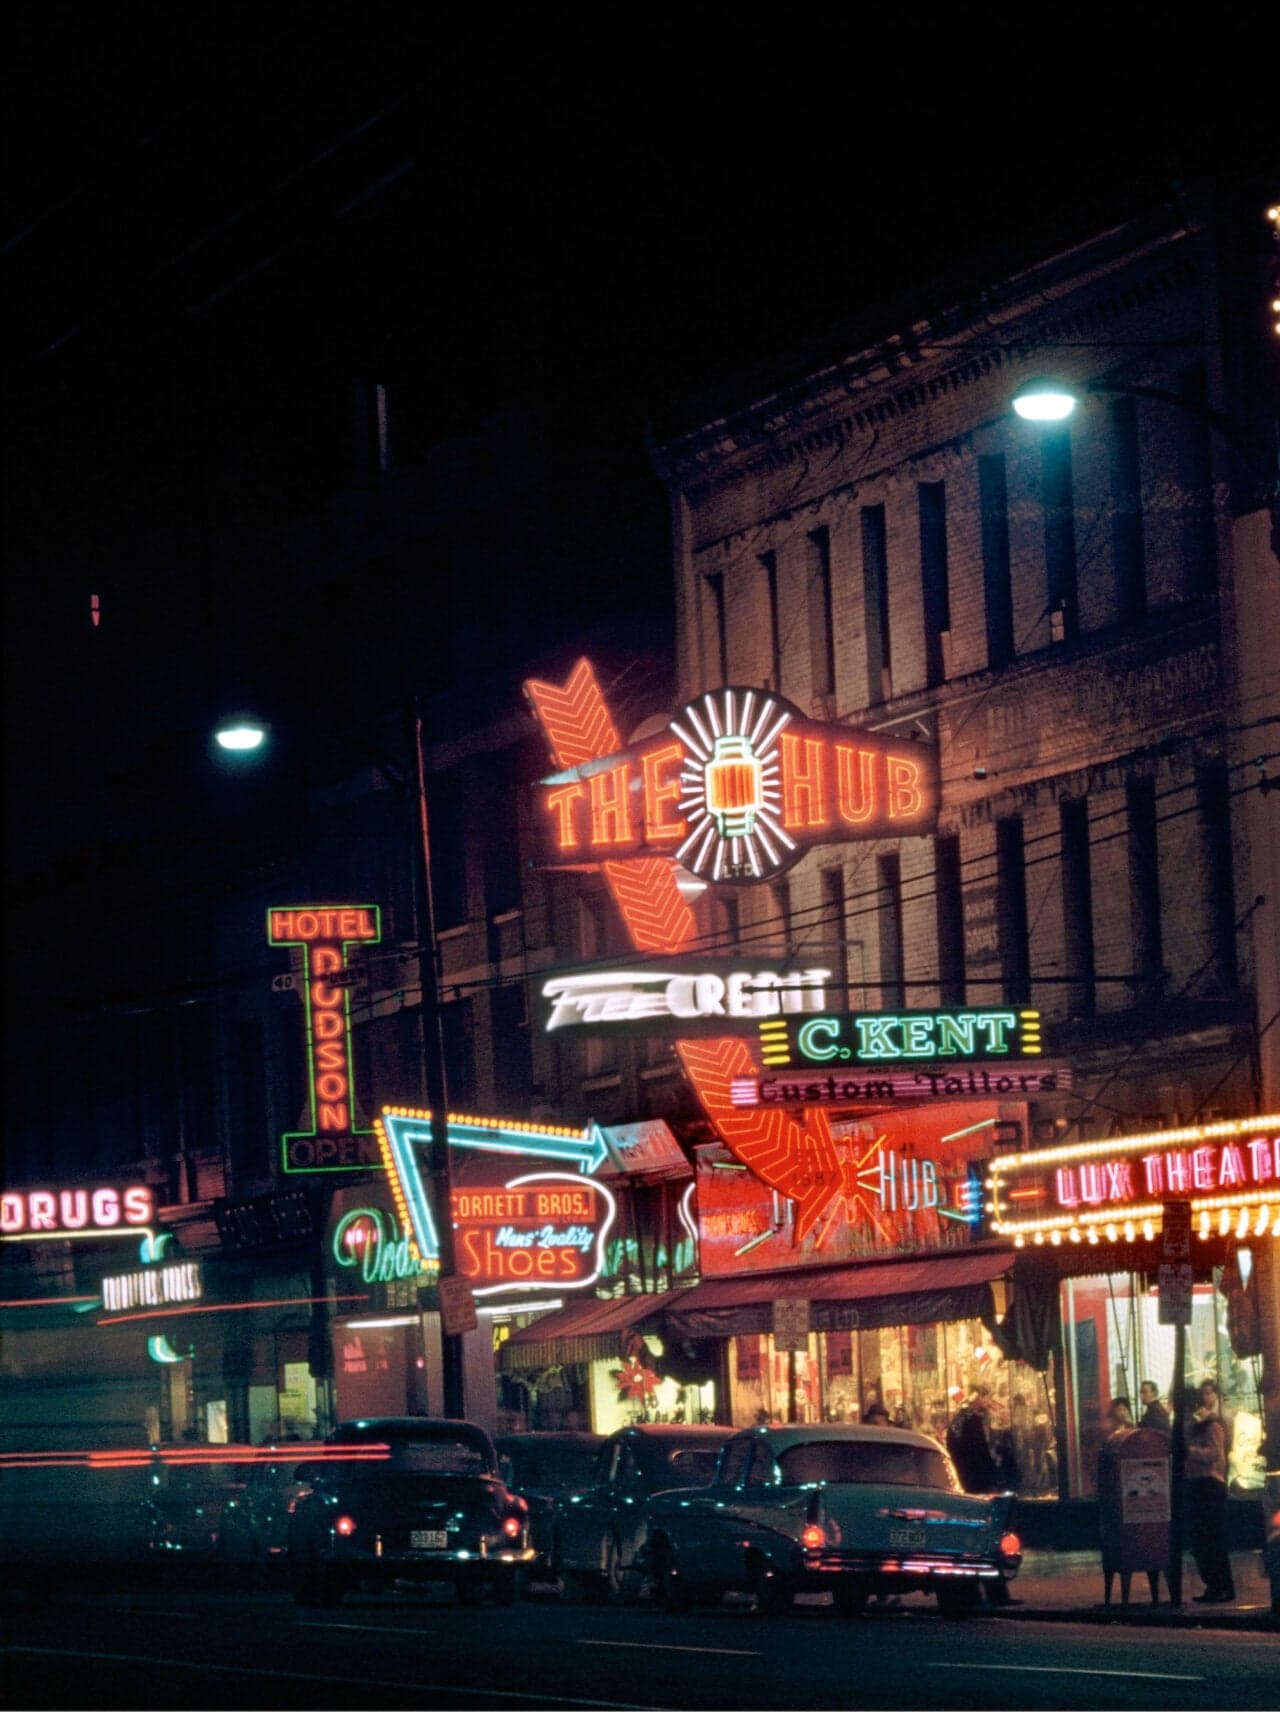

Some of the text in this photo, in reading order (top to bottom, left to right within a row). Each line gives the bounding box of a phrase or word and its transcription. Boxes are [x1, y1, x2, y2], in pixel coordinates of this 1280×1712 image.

[547, 733, 924, 848] THE HUB
[271, 909, 376, 940] HOTEL
[857, 1009, 1018, 1058] KENT
[758, 1070, 1058, 1101] Custom Tailors
[878, 1148, 940, 1212] HUB
[1055, 1161, 1132, 1207] LUX
[0, 1185, 153, 1232] DRUGS
[538, 1192, 589, 1217] BROS.
[464, 1231, 579, 1277] Shoes
[537, 1225, 594, 1253] Quality
